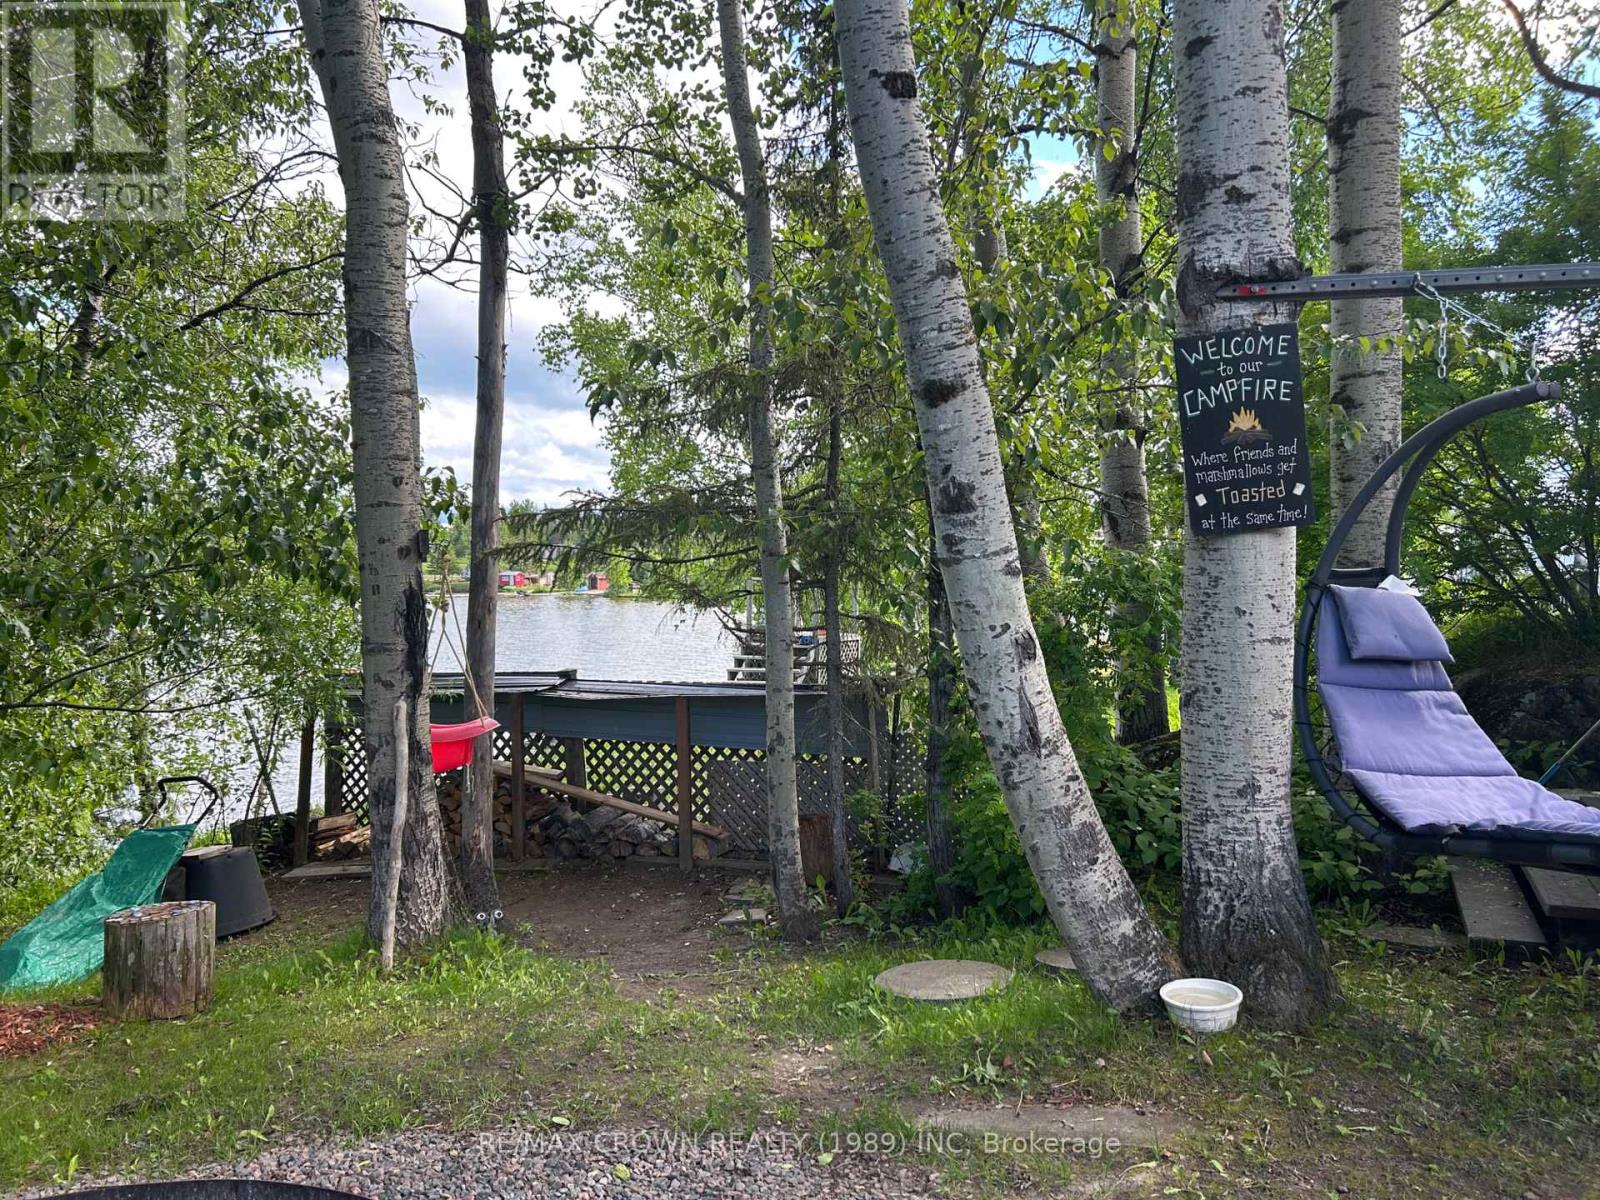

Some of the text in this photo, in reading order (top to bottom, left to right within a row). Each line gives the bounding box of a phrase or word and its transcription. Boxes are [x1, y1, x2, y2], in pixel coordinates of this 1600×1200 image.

[1181, 335, 1291, 365] WELCOME
[1217, 360, 1263, 377] to our
[1183, 377, 1293, 417] CAMPFIRE
[1191, 438, 1297, 466] Where friends and
[1196, 457, 1297, 484] marshmallows get
[1216, 479, 1286, 505] Toasted
[1201, 514, 1216, 530] at
[1220, 507, 1241, 526] the
[1279, 503, 1308, 522] time!
